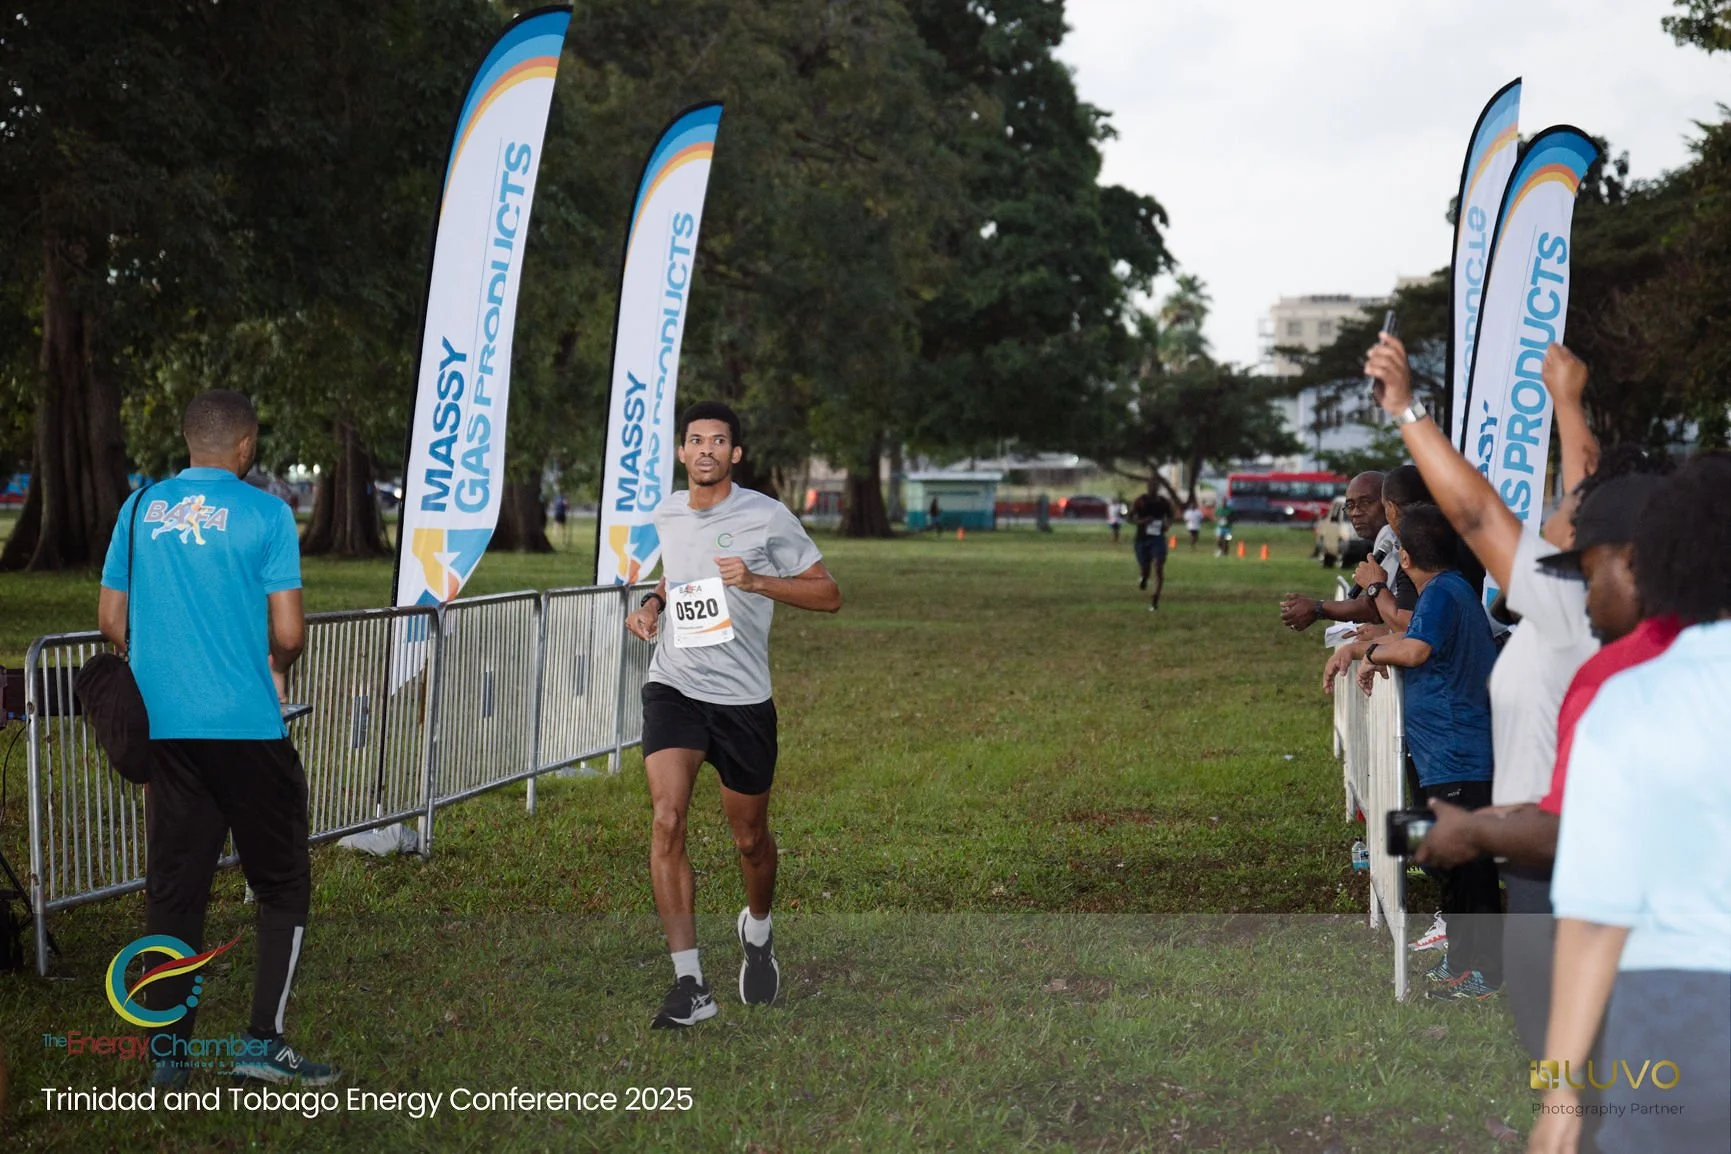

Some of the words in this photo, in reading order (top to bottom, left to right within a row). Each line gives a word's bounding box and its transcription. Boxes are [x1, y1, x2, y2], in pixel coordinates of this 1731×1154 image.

[454, 413, 491, 513] GAS
[473, 142, 532, 407] PRODUCTS
[1502, 231, 1568, 475] PRODUCTS
[421, 336, 467, 512] MASSY
[616, 369, 647, 512] MASSY
[676, 598, 719, 621] 0520
